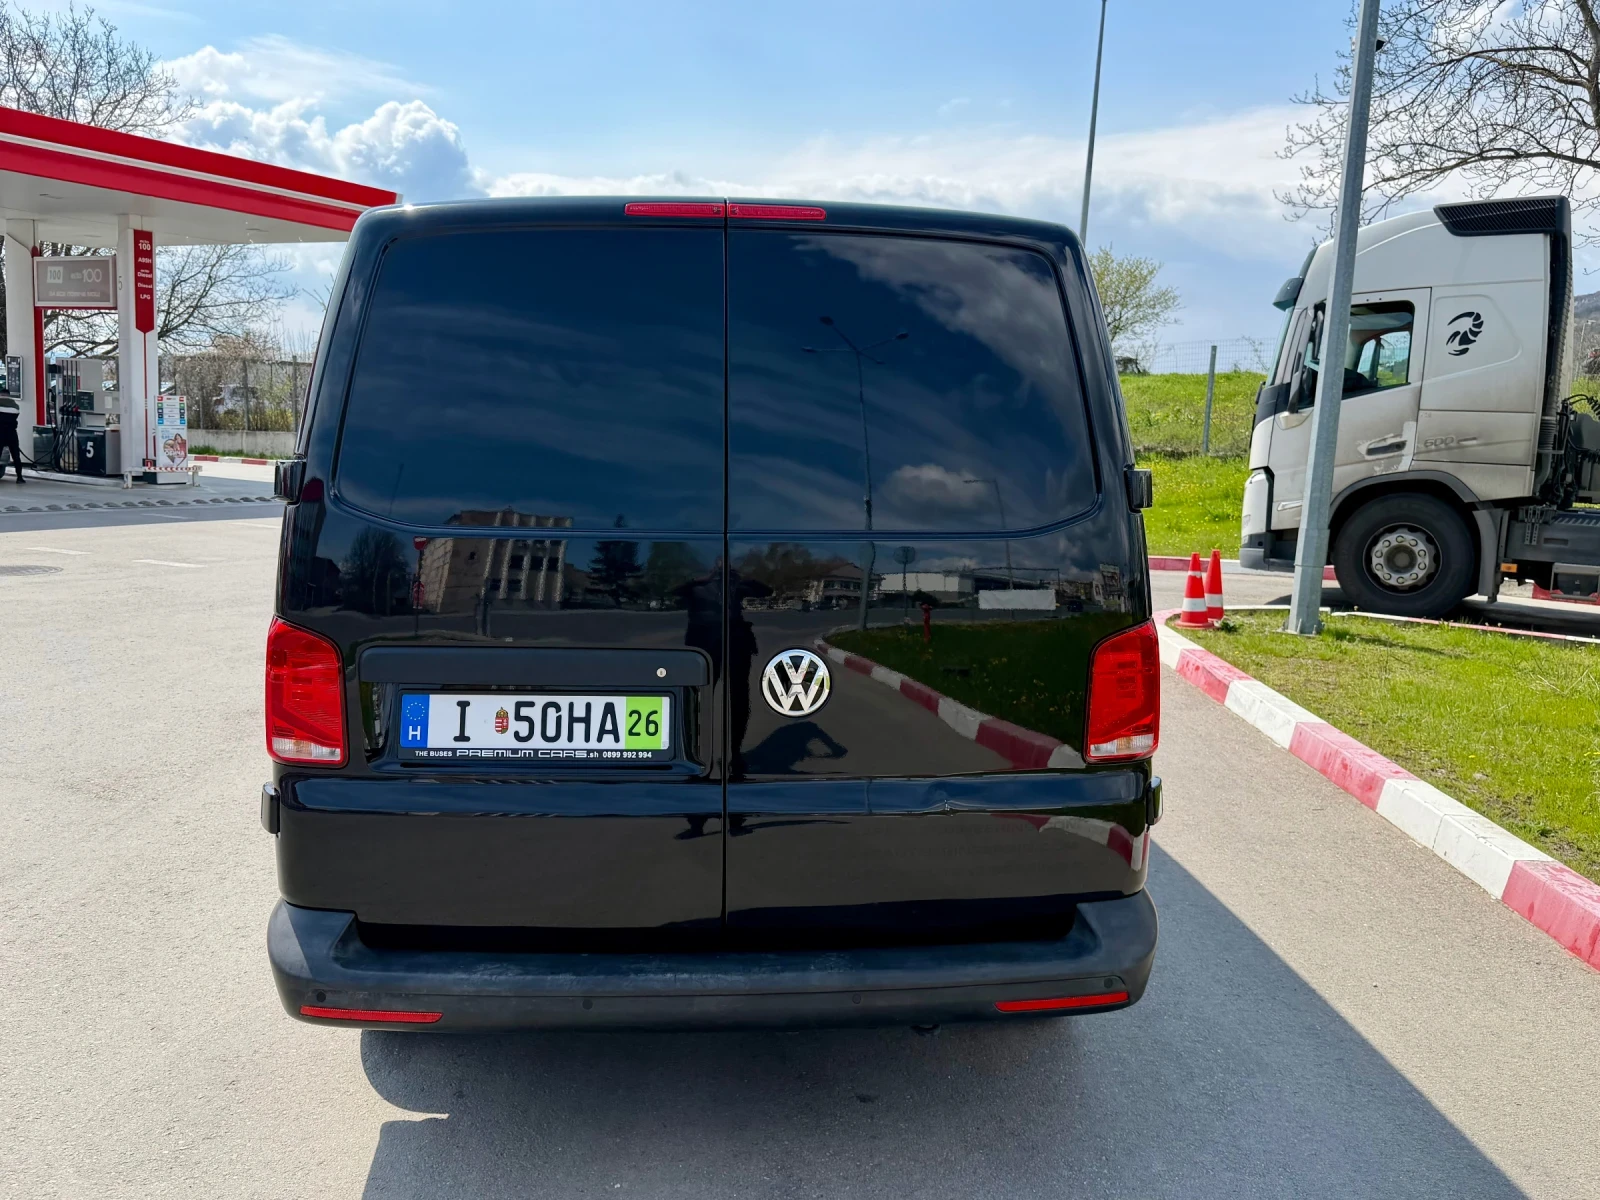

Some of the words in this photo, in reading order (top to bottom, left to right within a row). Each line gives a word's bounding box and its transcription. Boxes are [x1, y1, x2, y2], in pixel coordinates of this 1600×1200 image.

[82, 268, 102, 283] 100
[86, 441, 94, 458] 5
[1424, 436, 1455, 448] 600
[628, 709, 659, 737] 26
[408, 725, 421, 741] H
[456, 749, 534, 758] PREMIUM
